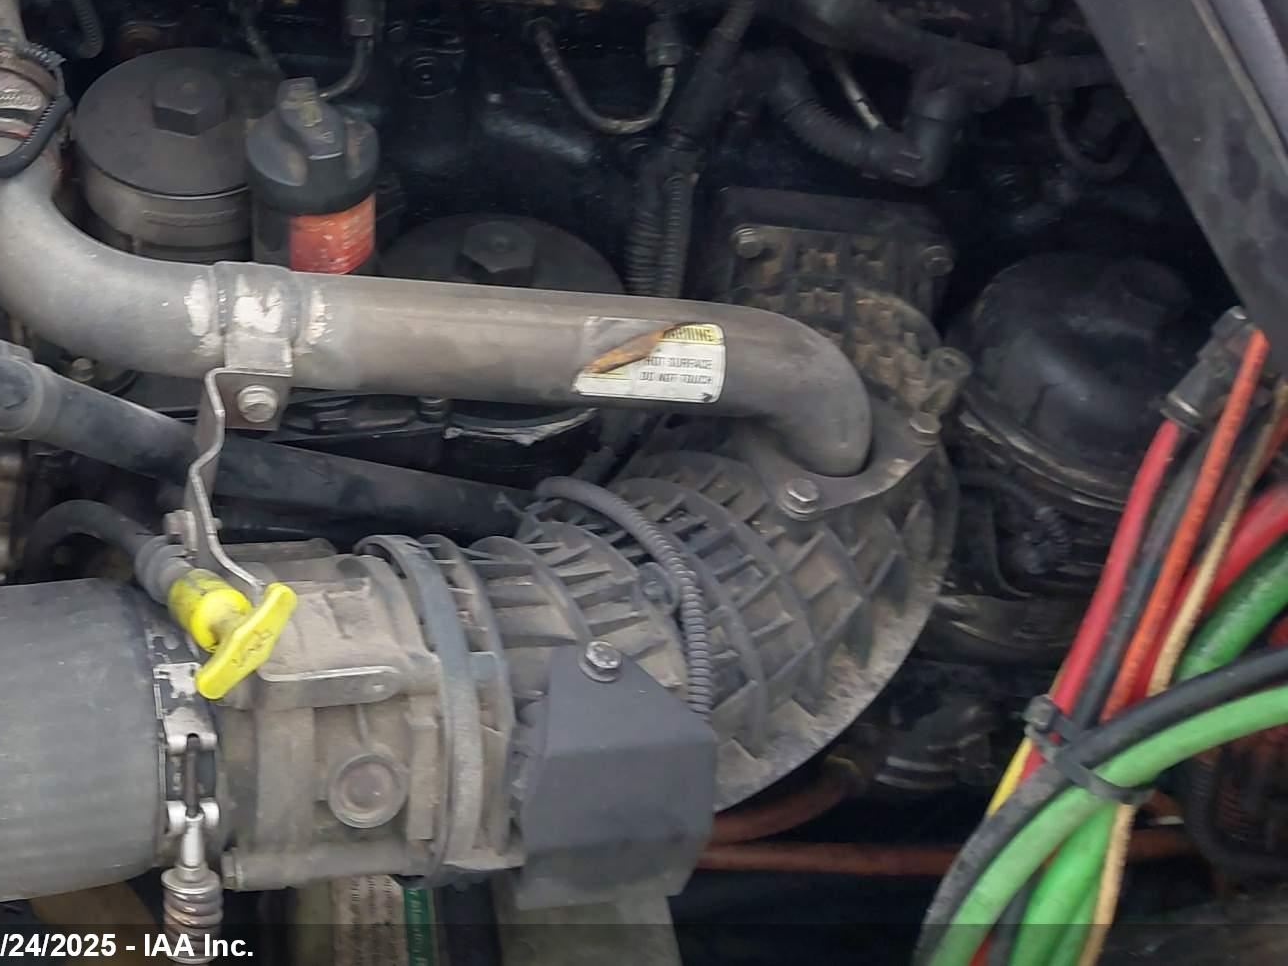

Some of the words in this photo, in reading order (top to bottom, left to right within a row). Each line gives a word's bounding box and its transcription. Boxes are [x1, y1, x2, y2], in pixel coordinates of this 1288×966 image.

[668, 357, 713, 370] SURFACE
[639, 372, 654, 382] DO
[659, 373, 679, 383] NOT
[680, 374, 713, 385] TOUCH
